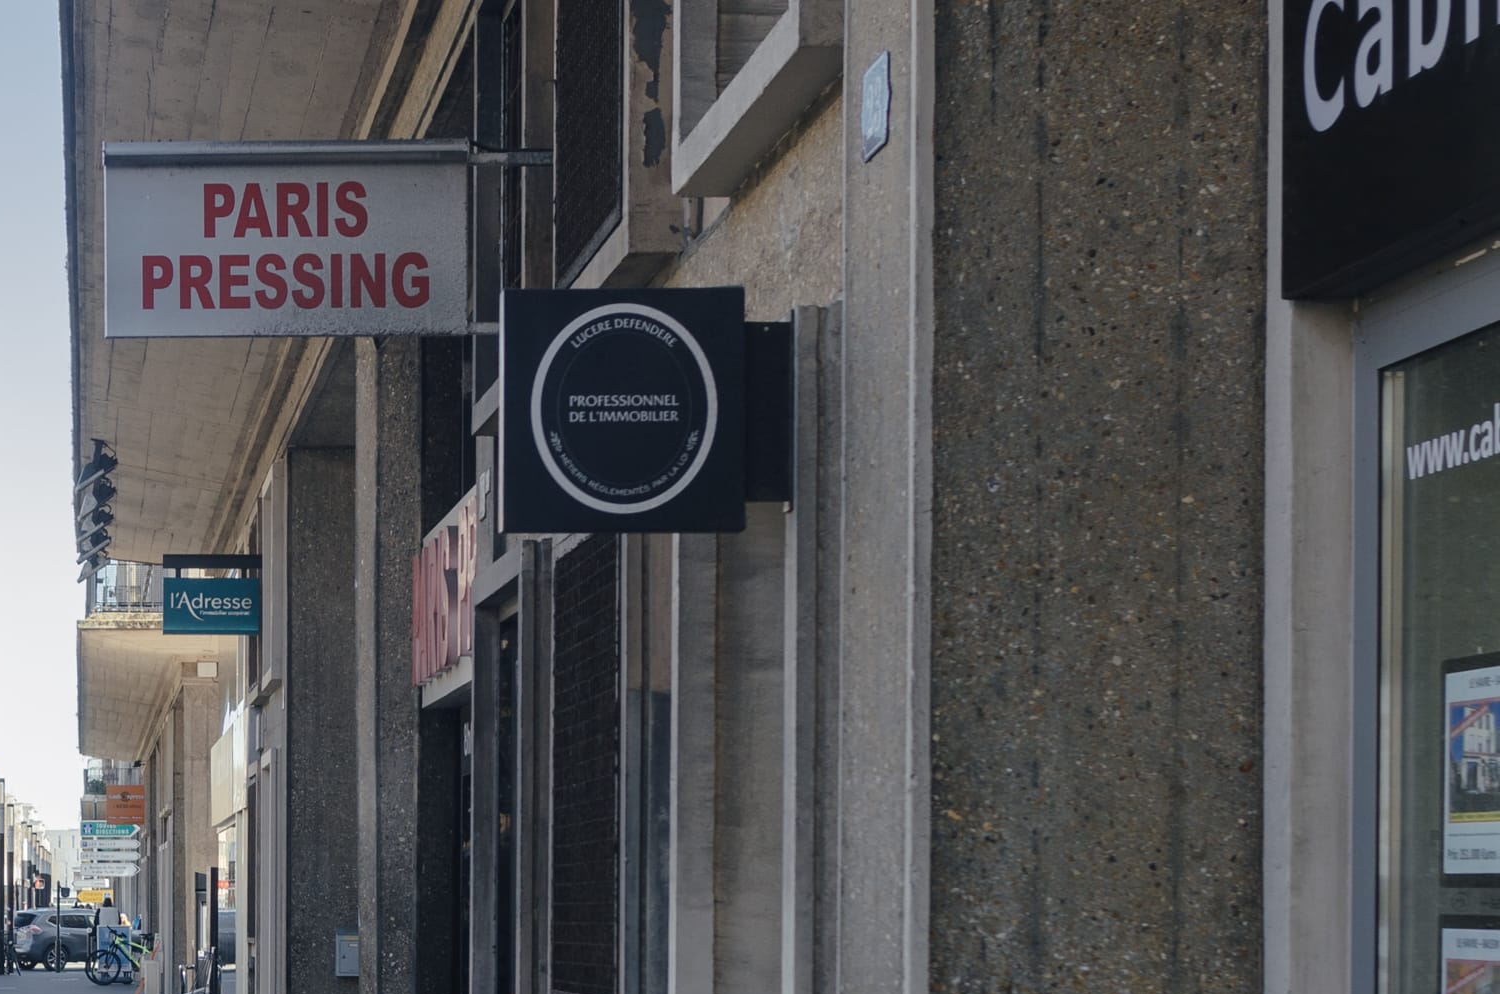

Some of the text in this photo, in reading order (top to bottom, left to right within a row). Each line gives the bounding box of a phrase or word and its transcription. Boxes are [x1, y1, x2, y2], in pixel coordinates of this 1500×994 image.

[1303, 0, 1500, 132] Cab
[203, 181, 368, 238] PARIS
[142, 251, 430, 310] PRESSING
[571, 318, 678, 349] LUCERE DEFENDERE
[569, 394, 679, 407] PROFESSIONNEL
[569, 410, 679, 423] DE L'IMMOBILIER
[652, 476, 668, 488] PAR
[670, 466, 679, 478] LA
[677, 453, 689, 467] LOI
[170, 591, 253, 622] l'Adresse
